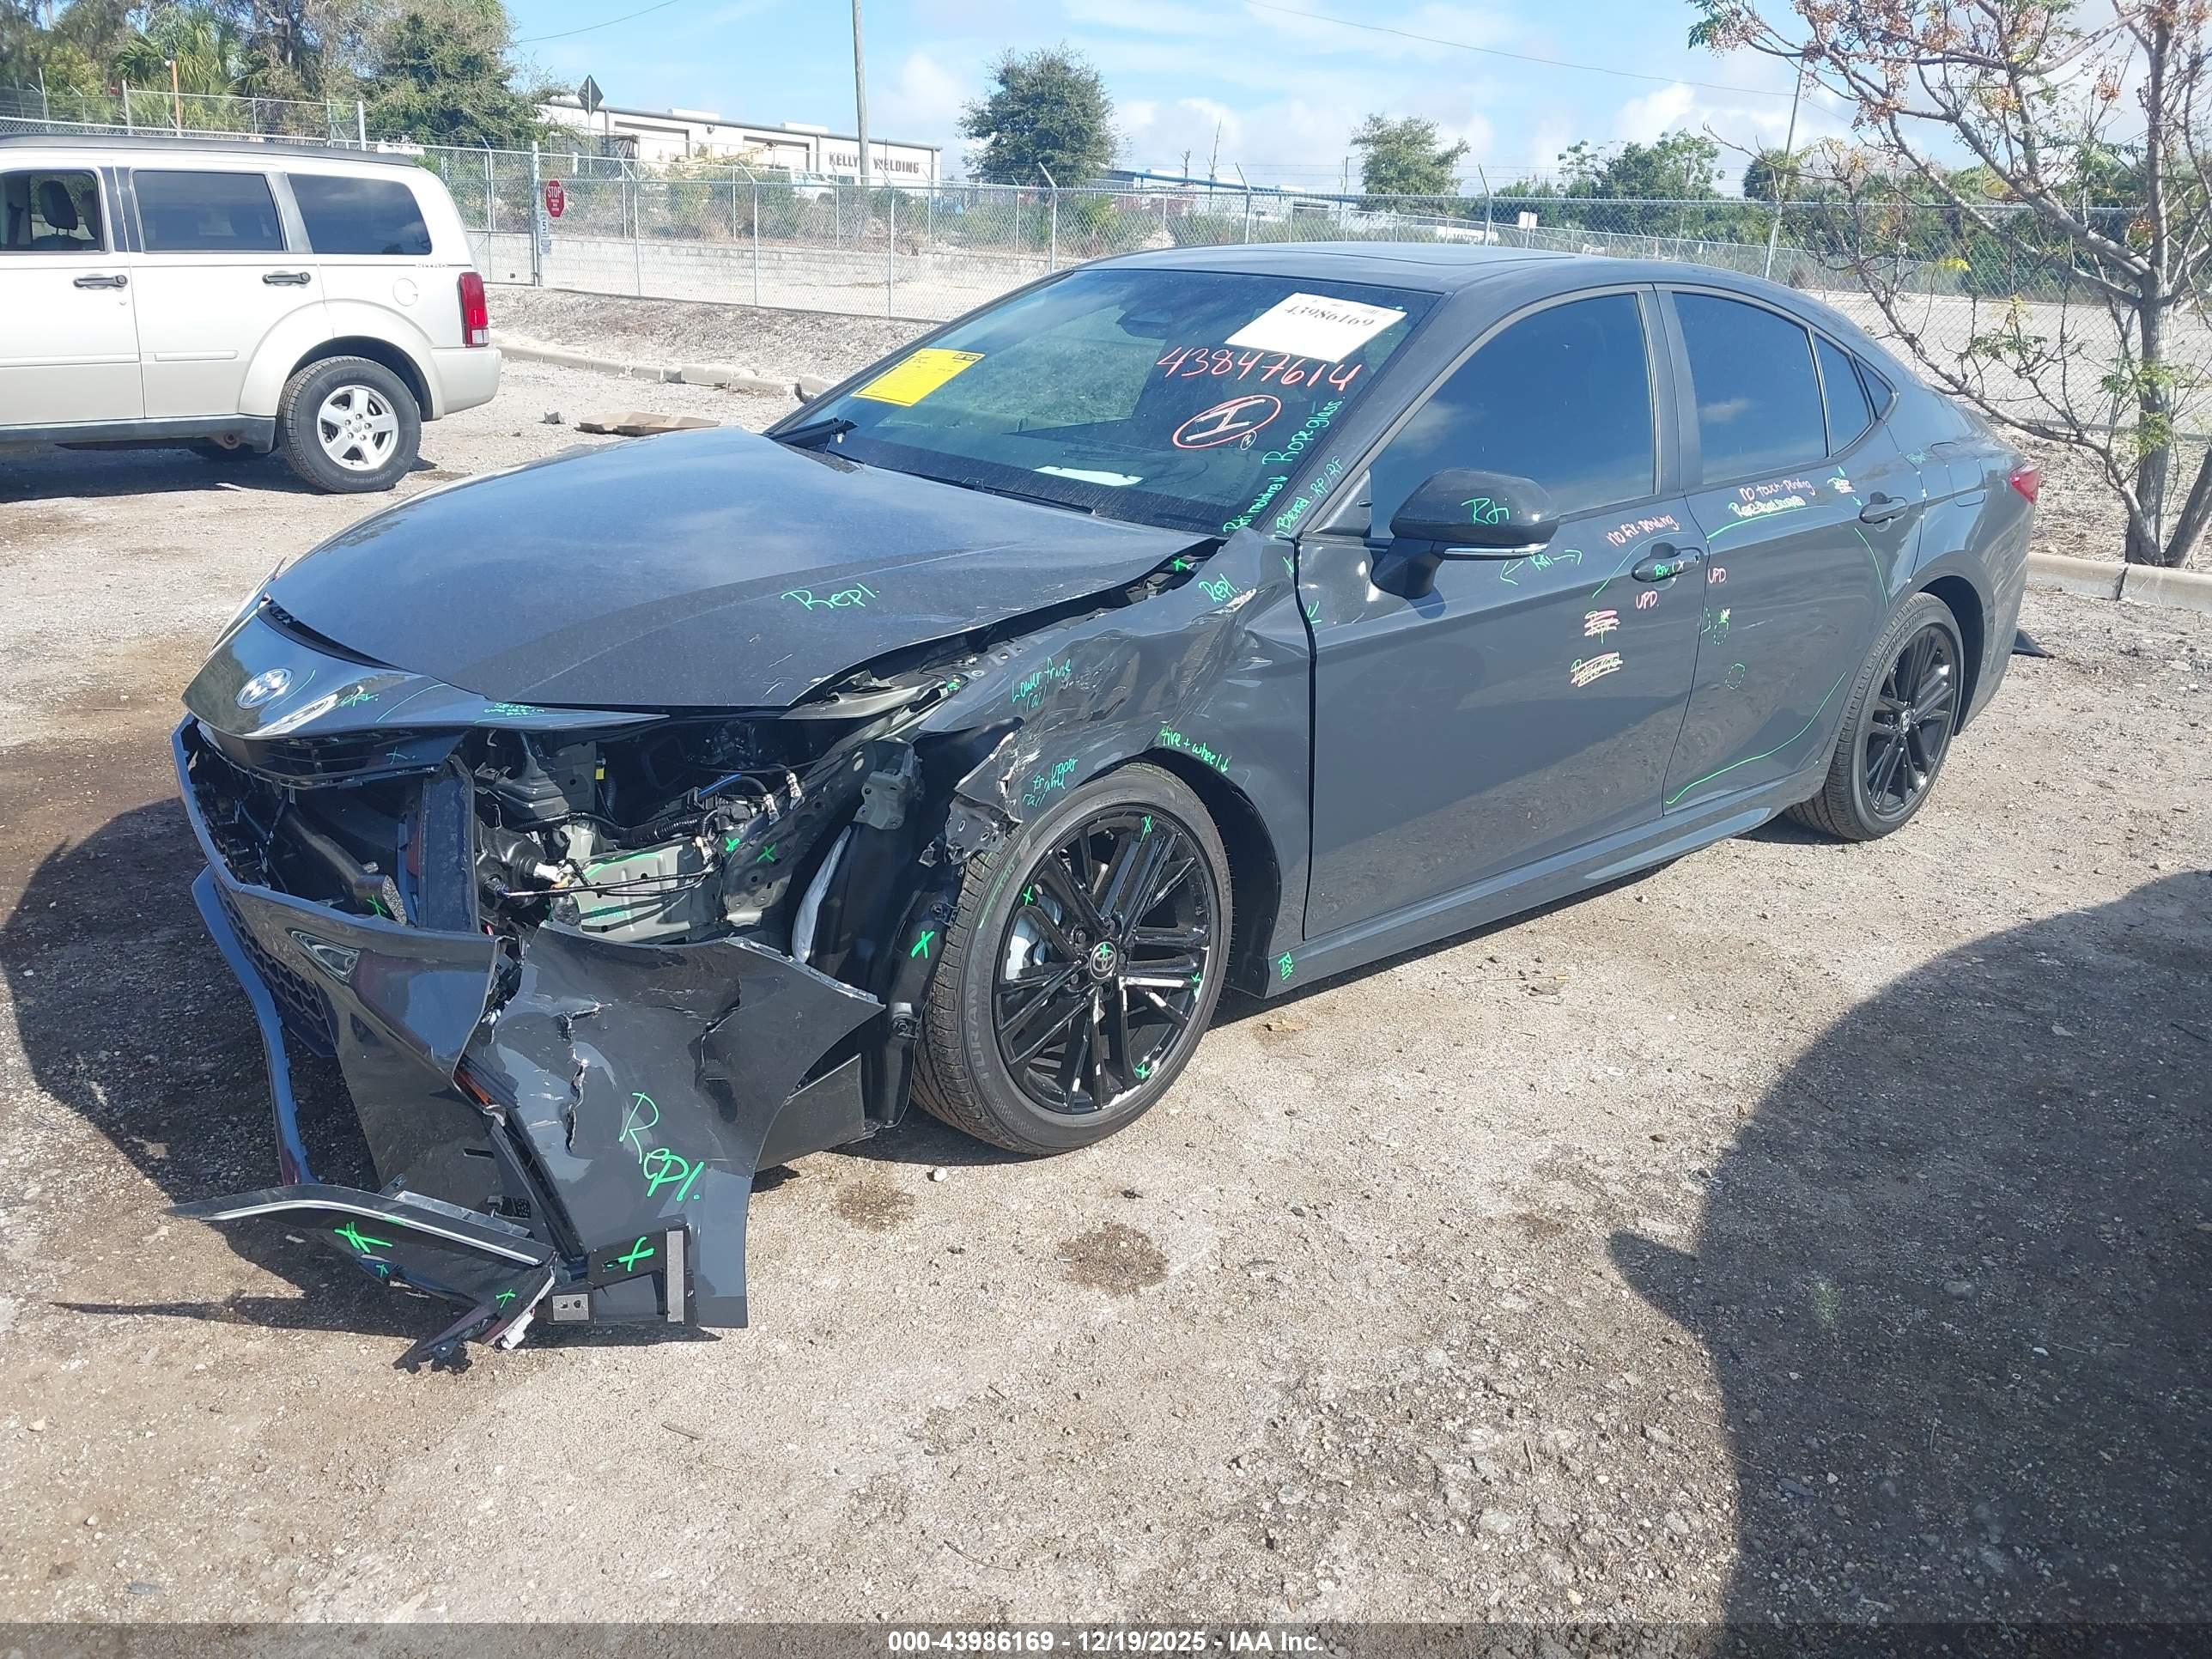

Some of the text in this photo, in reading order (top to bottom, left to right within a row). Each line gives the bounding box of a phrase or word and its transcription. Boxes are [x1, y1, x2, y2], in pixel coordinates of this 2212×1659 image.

[829, 151, 920, 173] KELLY WELDING
[547, 185, 562, 198] STOP
[1157, 346, 1363, 392] 43847614
[1012, 671, 1042, 702] Lower
[1026, 685, 1047, 712] rail
[1022, 791, 1046, 808] rail
